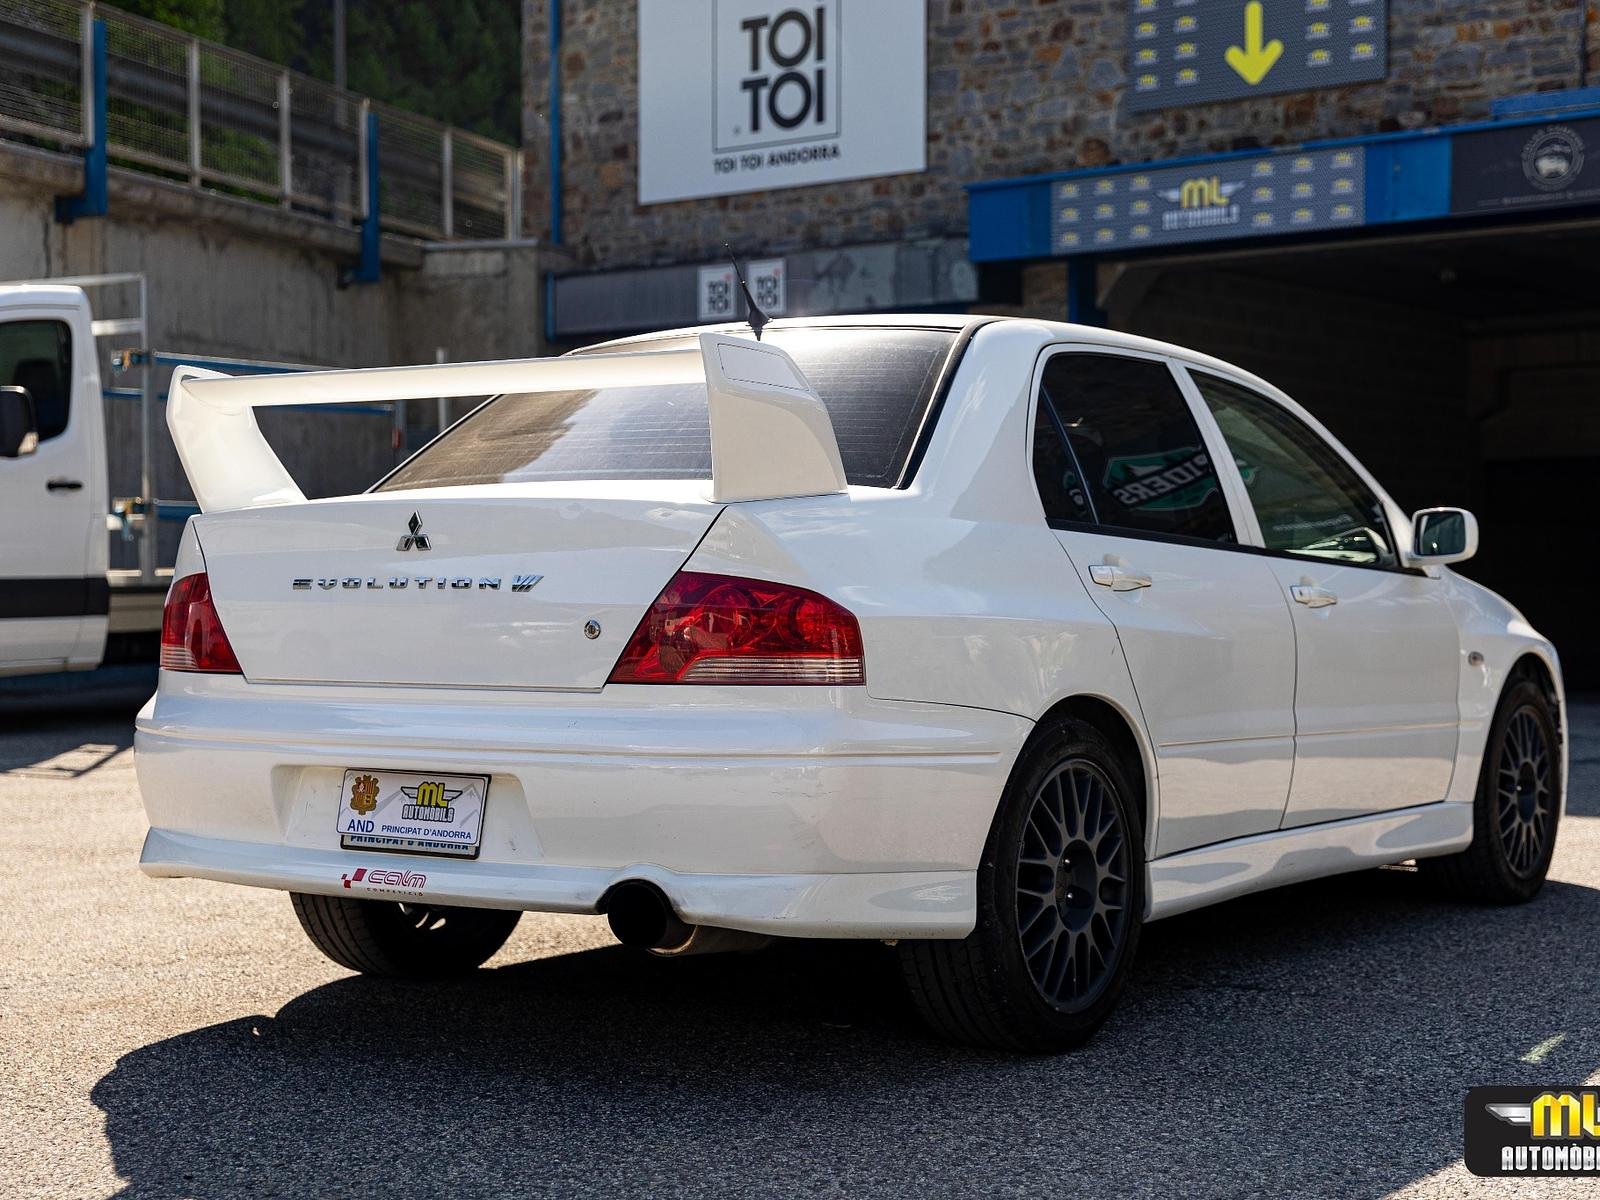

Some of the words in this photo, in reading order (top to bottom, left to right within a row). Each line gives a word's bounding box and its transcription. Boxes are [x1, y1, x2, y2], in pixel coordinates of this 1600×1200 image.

[741, 6, 825, 71] TOI
[741, 68, 825, 132] TOI
[713, 157, 737, 174] TOI
[741, 153, 764, 171] TOI
[768, 145, 839, 166] ANDORRA
[1180, 175, 1229, 209] ML
[708, 281, 729, 295] TOI
[757, 275, 778, 291] TOI
[708, 297, 729, 313] TOI
[757, 290, 778, 307] TOI
[292, 576, 502, 590] EVOLUTION
[416, 781, 449, 807] ML
[347, 819, 375, 833] AND
[381, 824, 422, 836] PRINCIPAT
[423, 828, 472, 840] D'ANDORRA
